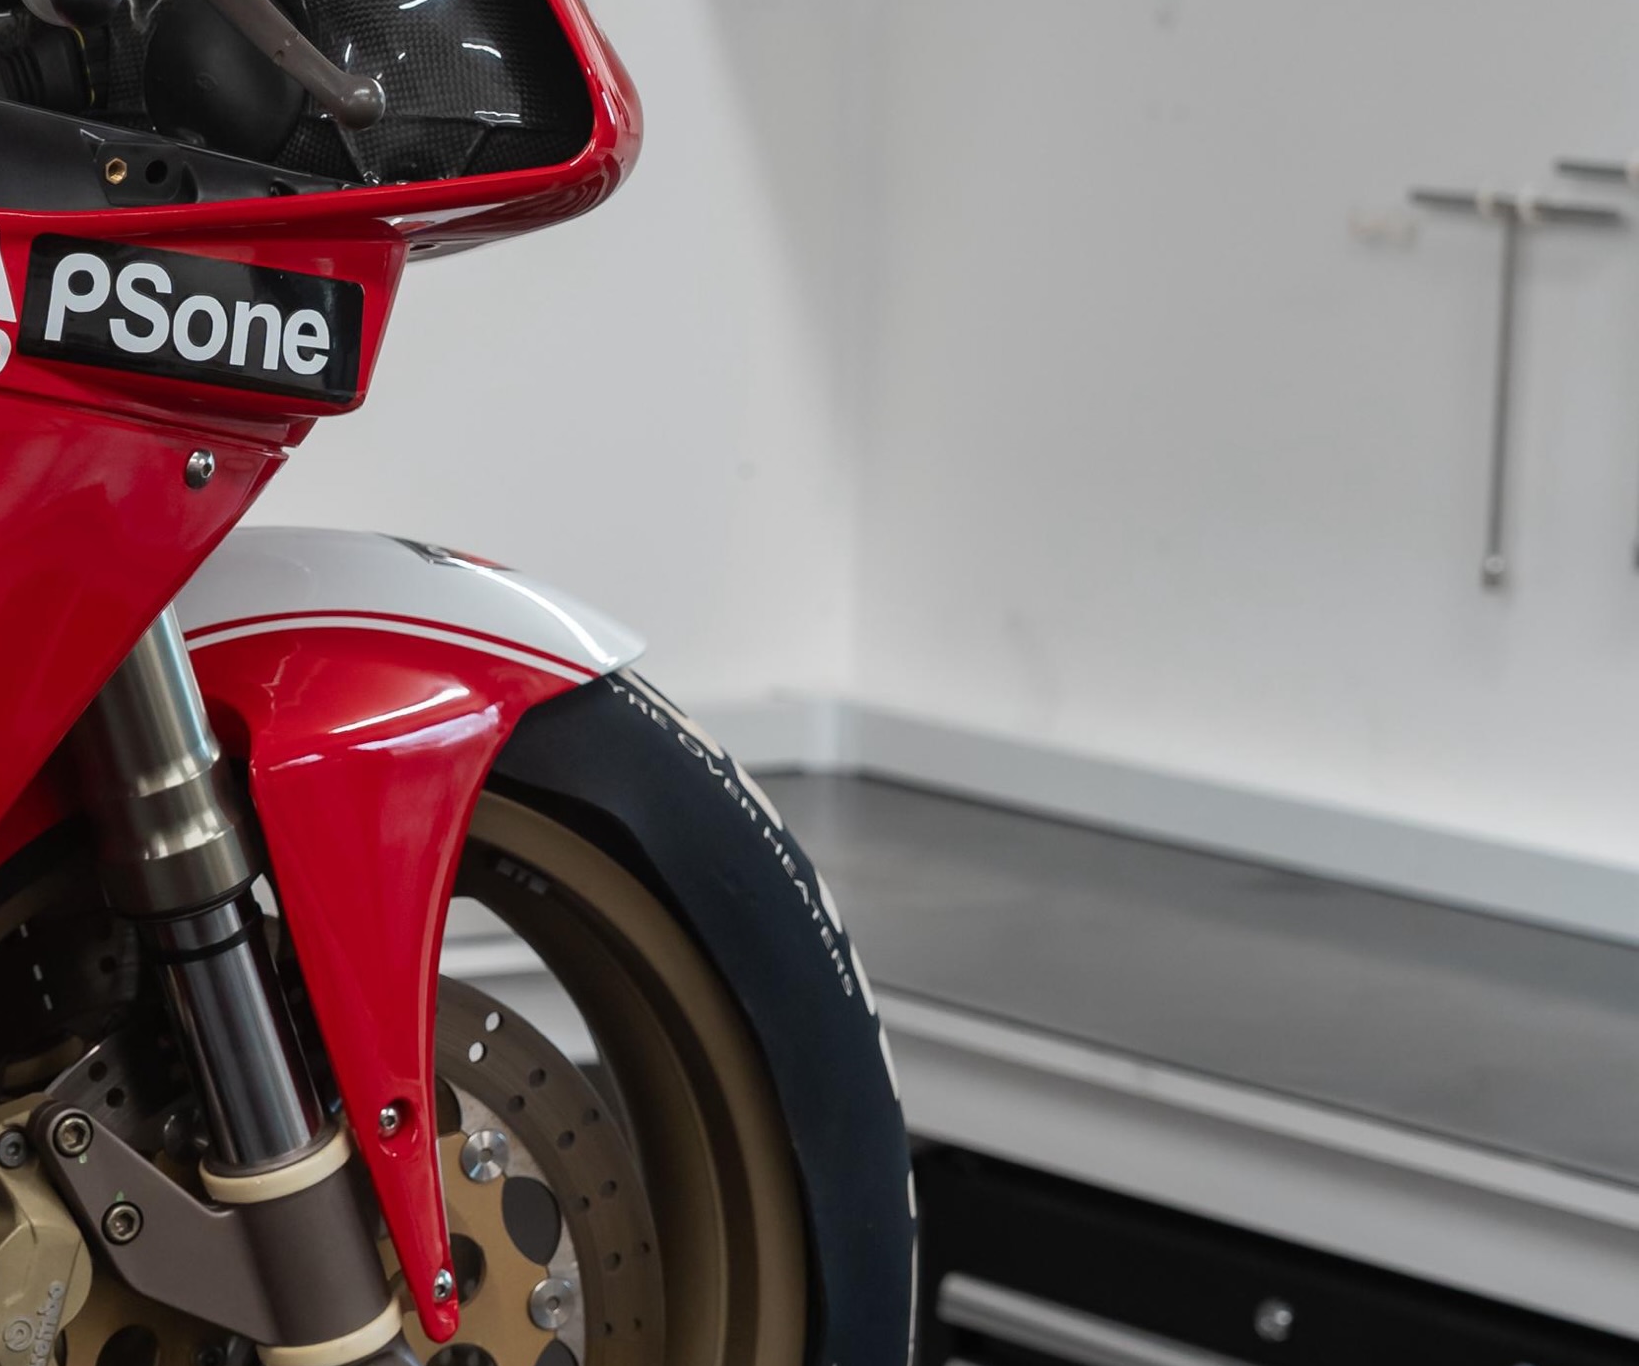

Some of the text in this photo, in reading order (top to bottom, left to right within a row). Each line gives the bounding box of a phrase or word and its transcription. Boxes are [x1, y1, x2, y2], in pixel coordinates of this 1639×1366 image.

[44, 251, 331, 376] PSone
[677, 733, 757, 822] OVER
[763, 826, 853, 997] HEATERS
